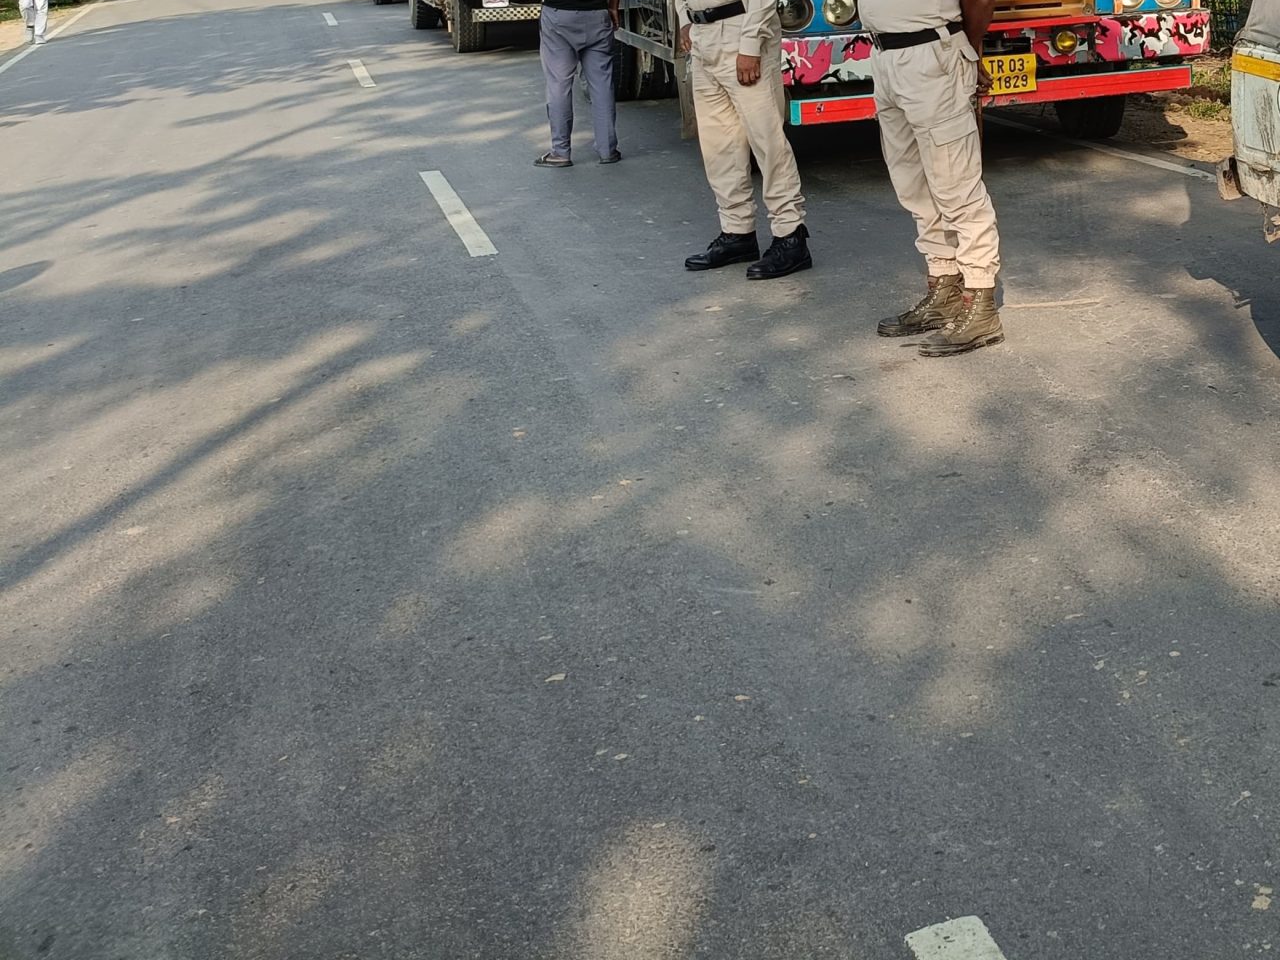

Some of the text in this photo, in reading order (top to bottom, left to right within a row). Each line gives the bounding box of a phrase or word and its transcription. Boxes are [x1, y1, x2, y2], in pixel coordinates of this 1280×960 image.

[989, 58, 1025, 74] TR 03
[991, 74, 1028, 90] 1829
